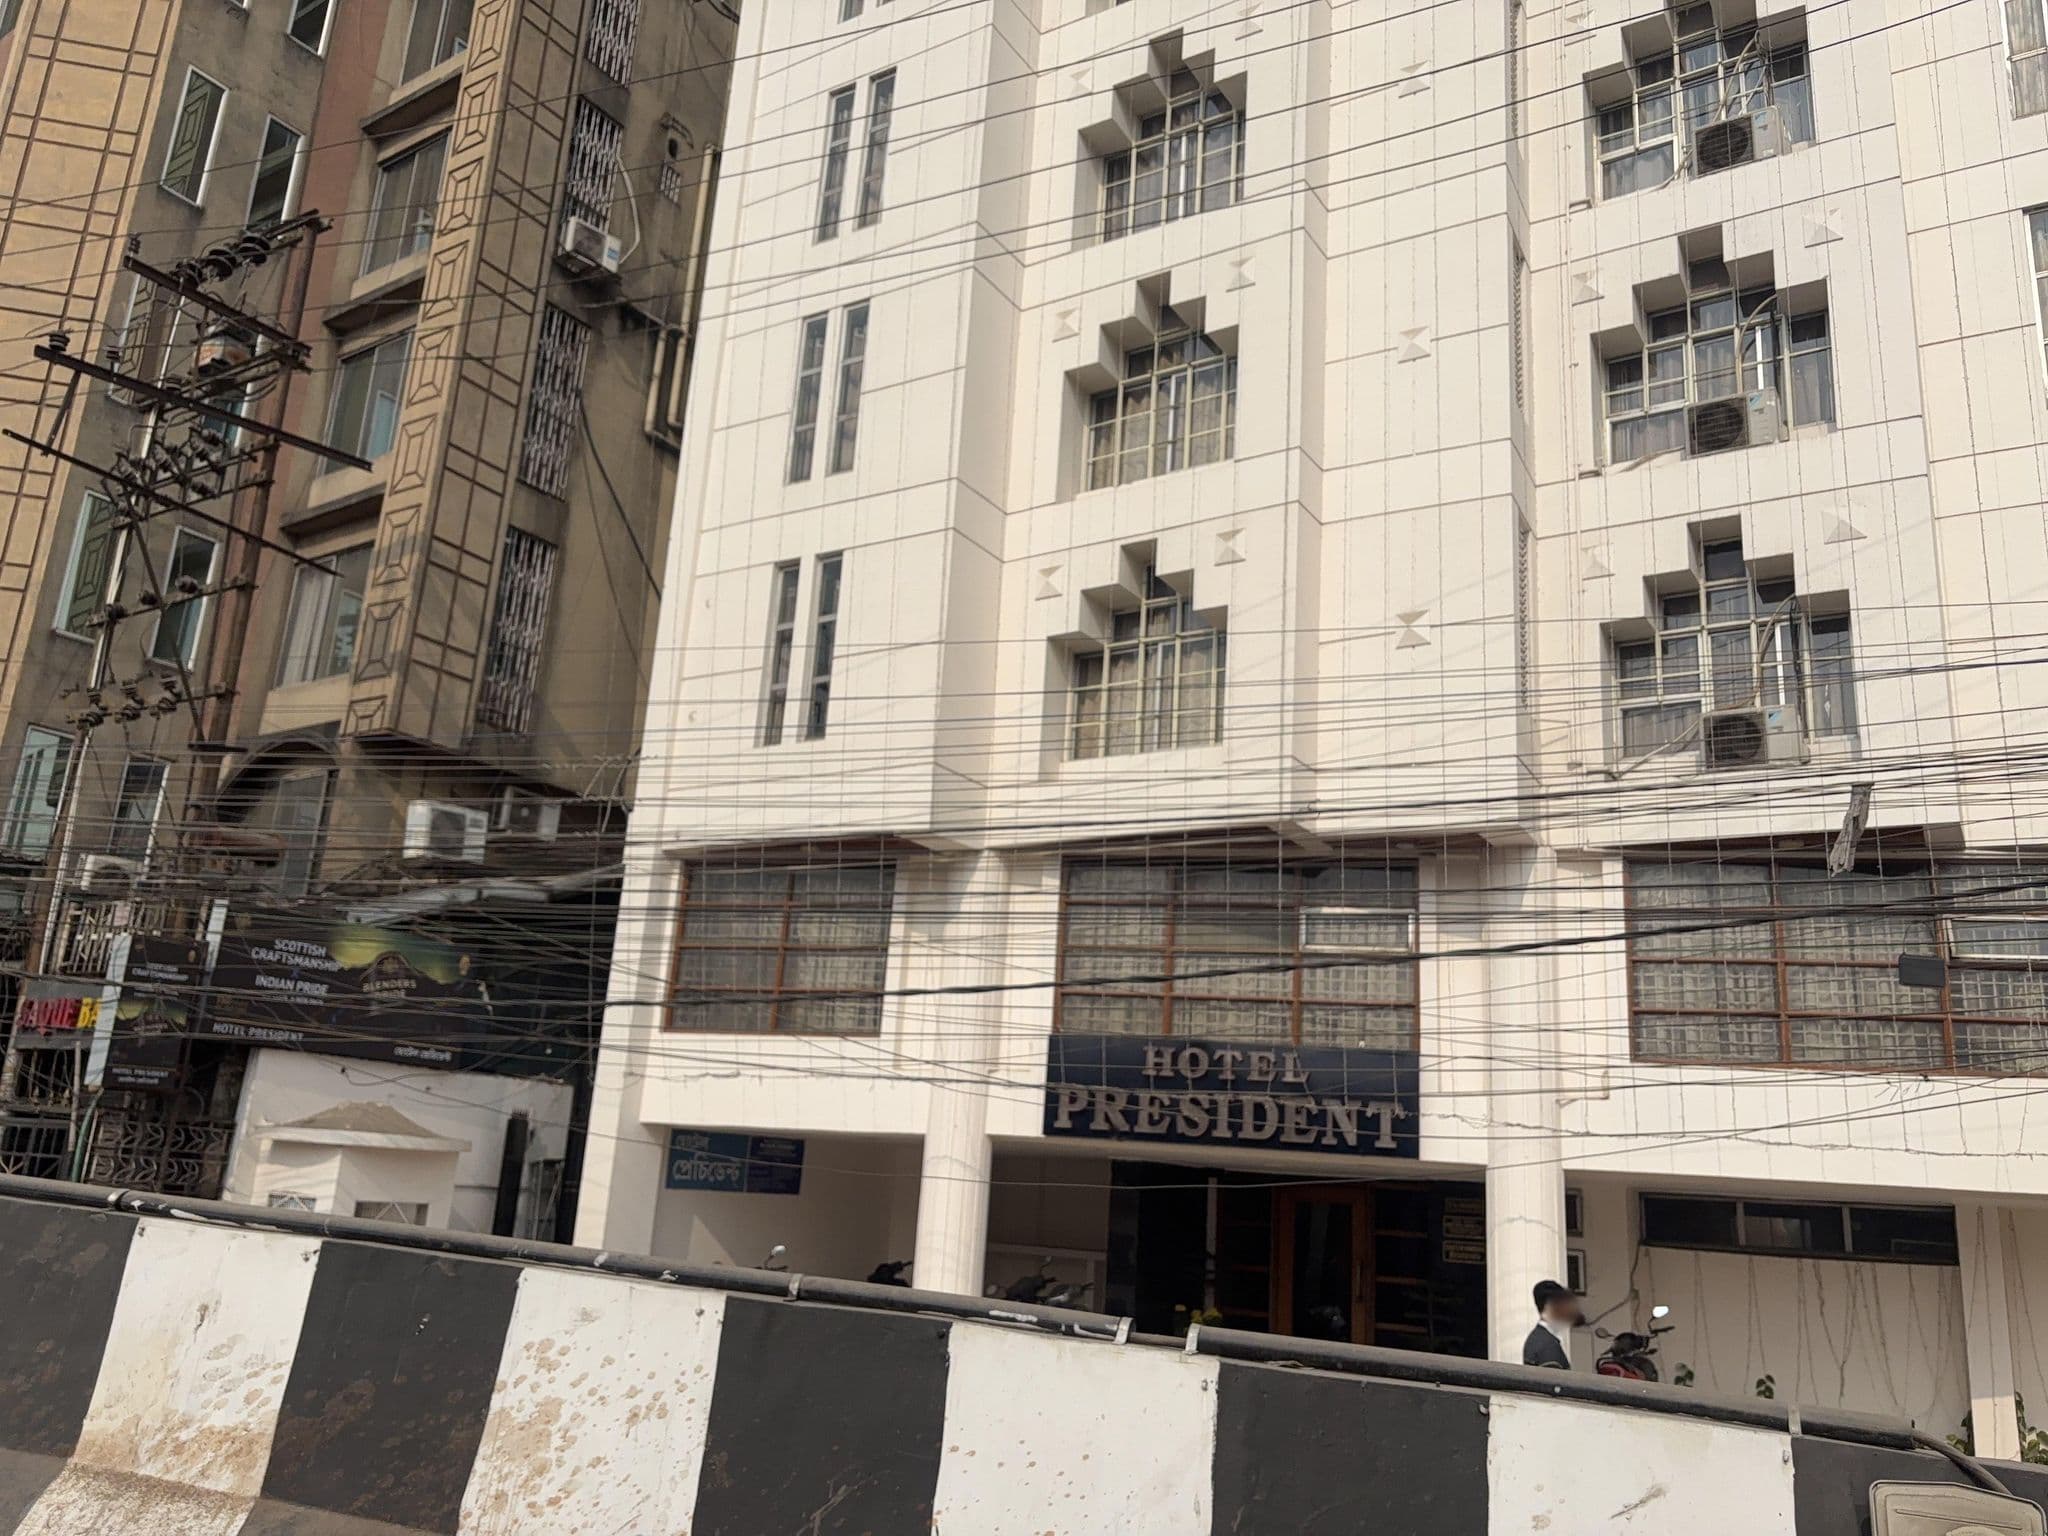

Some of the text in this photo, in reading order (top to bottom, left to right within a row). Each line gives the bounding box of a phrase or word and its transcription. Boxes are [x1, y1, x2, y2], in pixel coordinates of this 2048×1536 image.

[251, 946, 342, 972] CRAFTSMANSHIP
[274, 939, 326, 957] SCOTTISH
[255, 974, 329, 996] INDIAN PRIDE
[362, 979, 416, 993] BLENDERS
[212, 1022, 304, 1041] HOTEL PRESIDENT
[1142, 1046, 1311, 1084] HOTEL
[1053, 1086, 1405, 1149] PRESIDENT
